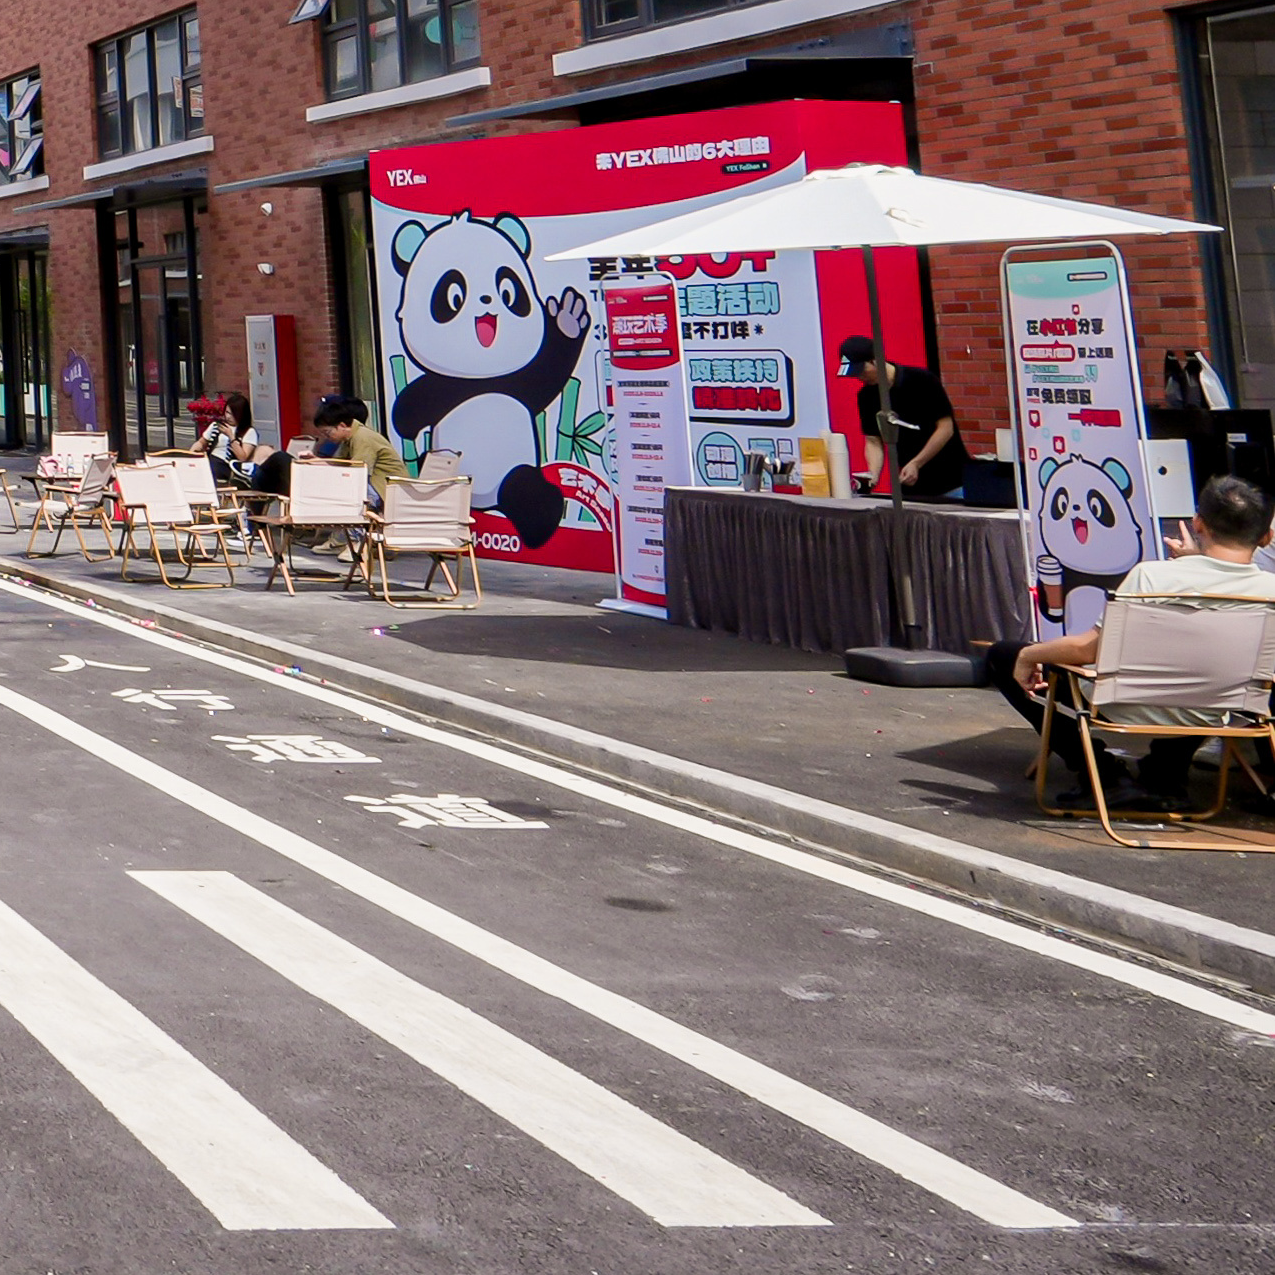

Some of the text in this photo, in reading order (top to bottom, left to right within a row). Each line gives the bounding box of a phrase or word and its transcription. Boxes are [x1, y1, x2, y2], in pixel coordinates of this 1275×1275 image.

[595, 136, 771, 171] 来YEX佛山的6大理由
[387, 170, 412, 187] YEX
